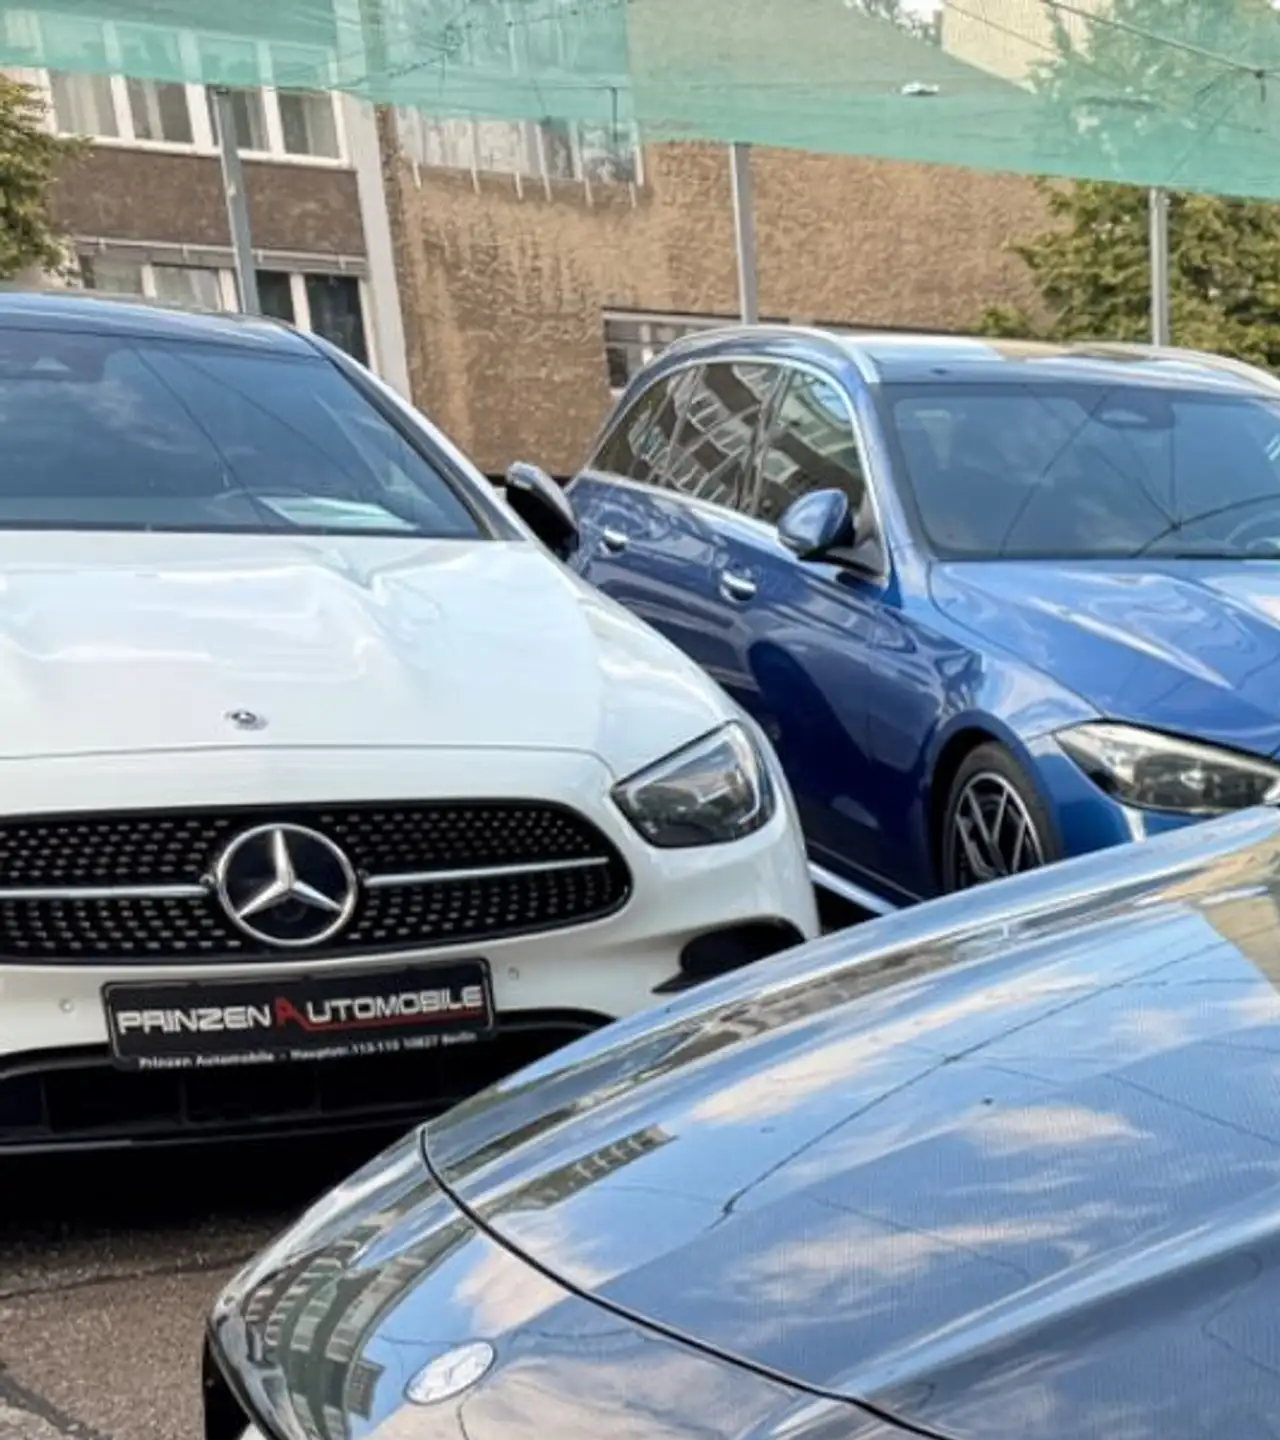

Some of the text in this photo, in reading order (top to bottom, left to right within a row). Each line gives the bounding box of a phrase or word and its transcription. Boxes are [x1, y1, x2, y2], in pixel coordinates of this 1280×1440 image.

[117, 985, 483, 1036] PRINZEN AUTOMOBILE
[138, 1055, 193, 1069] Prinzen
[196, 1051, 275, 1066] Automobile
